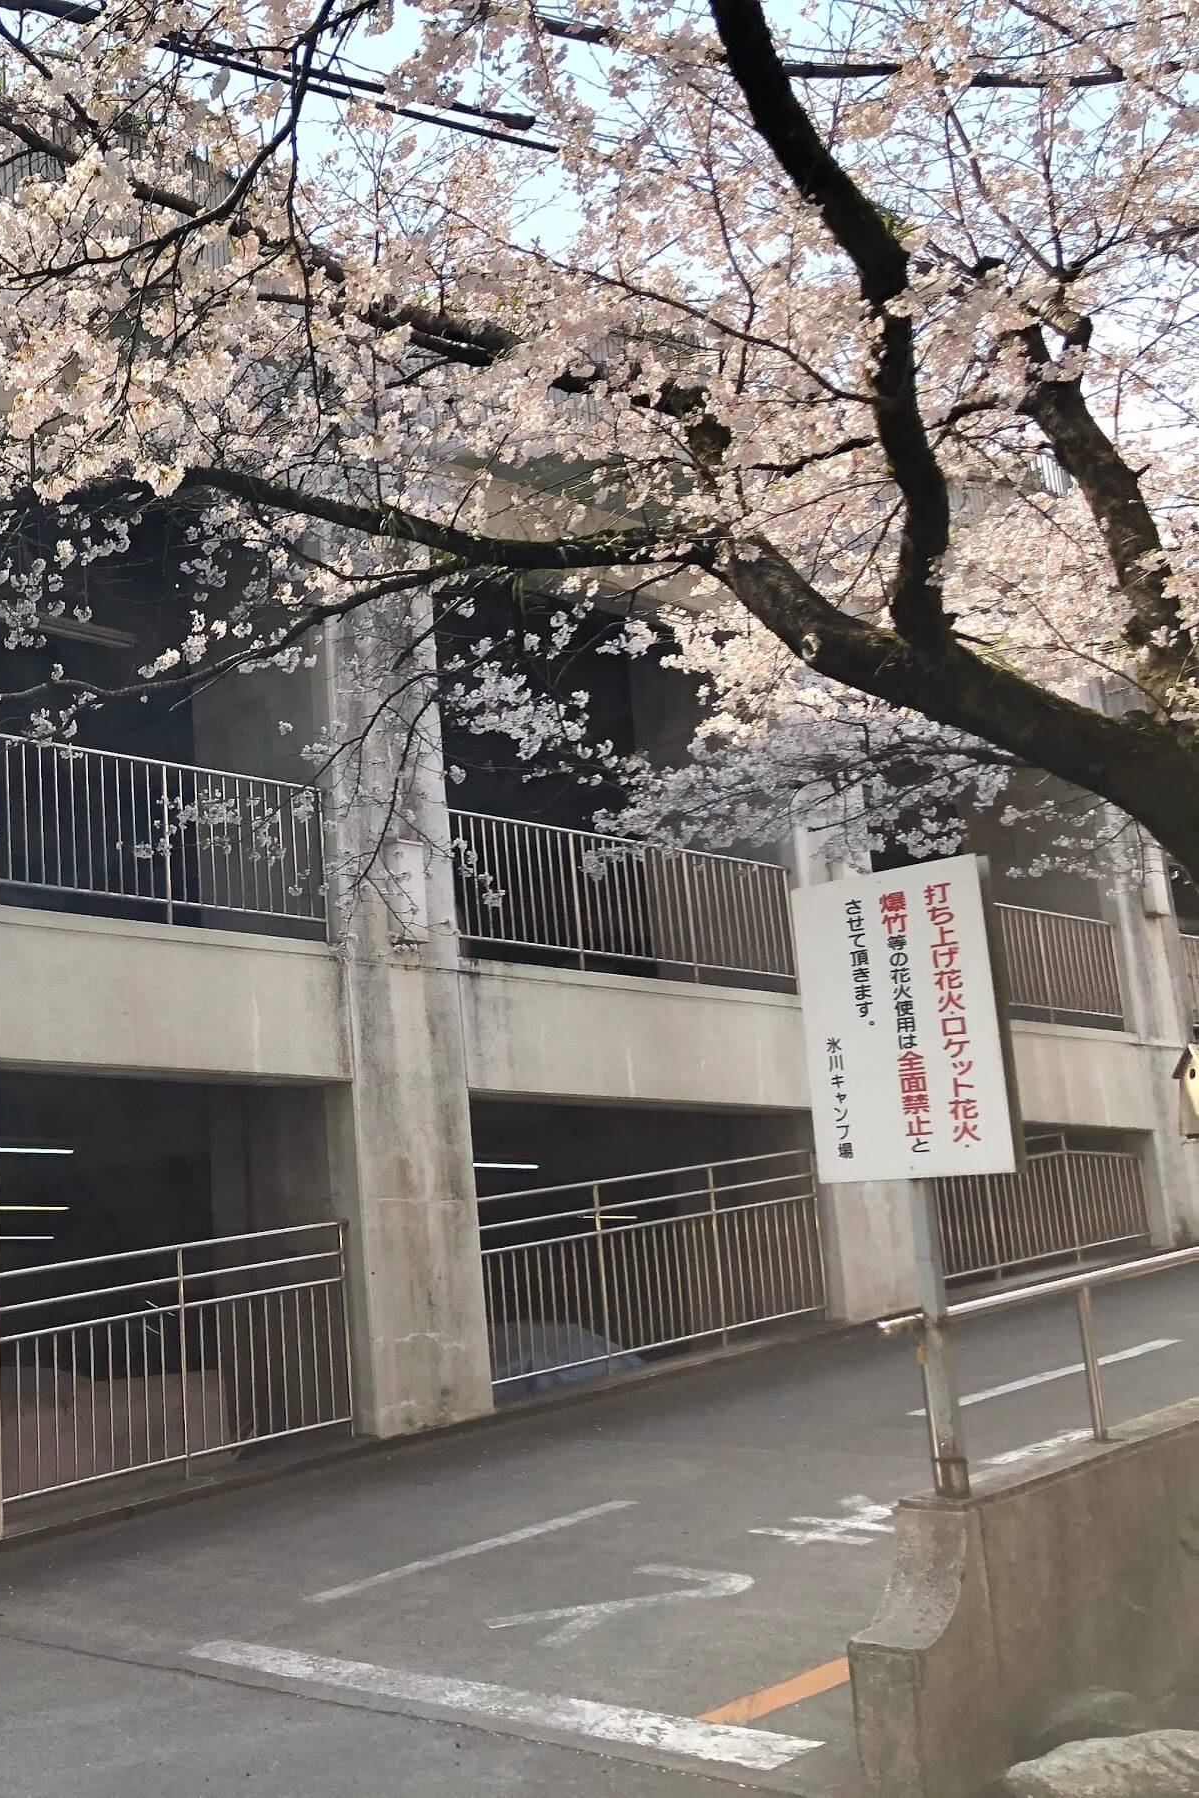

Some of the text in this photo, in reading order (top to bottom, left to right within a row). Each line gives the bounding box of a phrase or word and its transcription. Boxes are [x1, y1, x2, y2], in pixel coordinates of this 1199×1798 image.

[844, 899, 876, 1027] させて頂きます。
[878, 890, 933, 1154] 爆竹等の花火使用は全面禁止と
